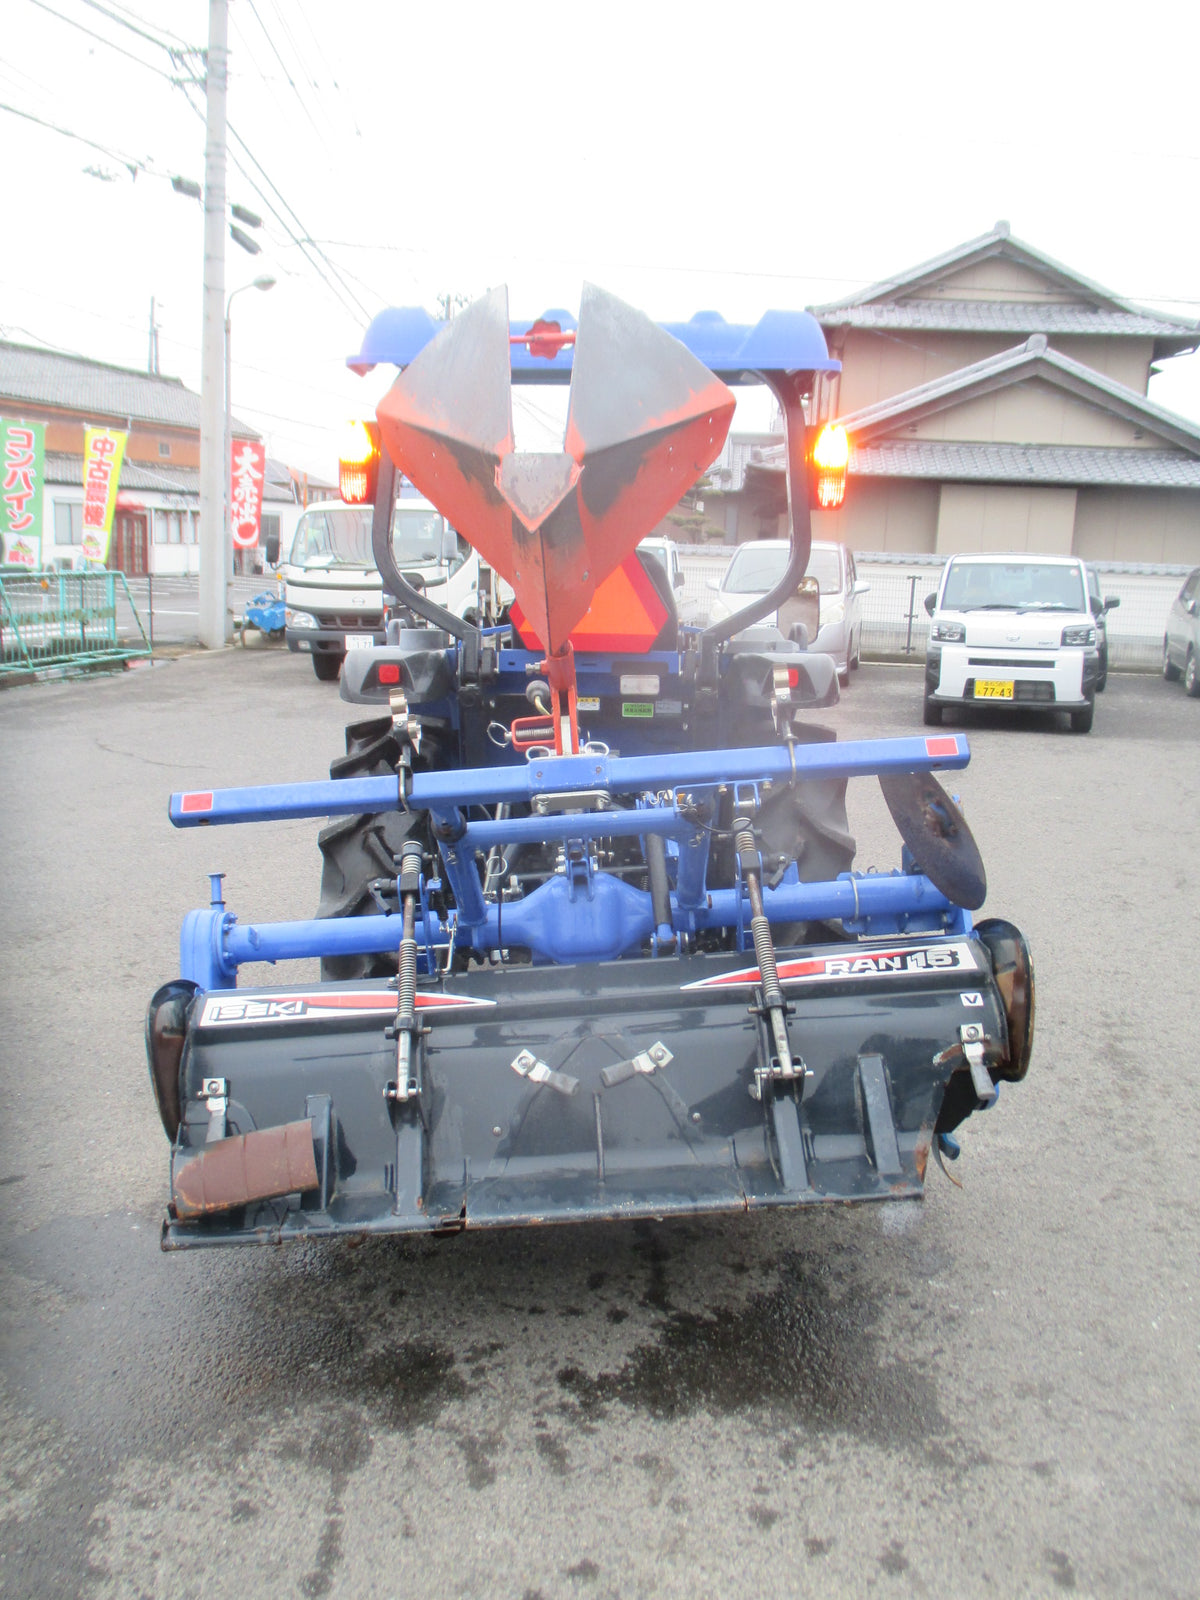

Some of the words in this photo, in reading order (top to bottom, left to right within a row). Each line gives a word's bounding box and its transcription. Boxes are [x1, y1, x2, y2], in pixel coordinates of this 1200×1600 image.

[4, 427, 35, 530] コンバイン
[84, 436, 117, 528] 中古農機
[825, 954, 901, 973] RAN
[907, 948, 959, 968] 15
[209, 1000, 307, 1021] ISEKI
